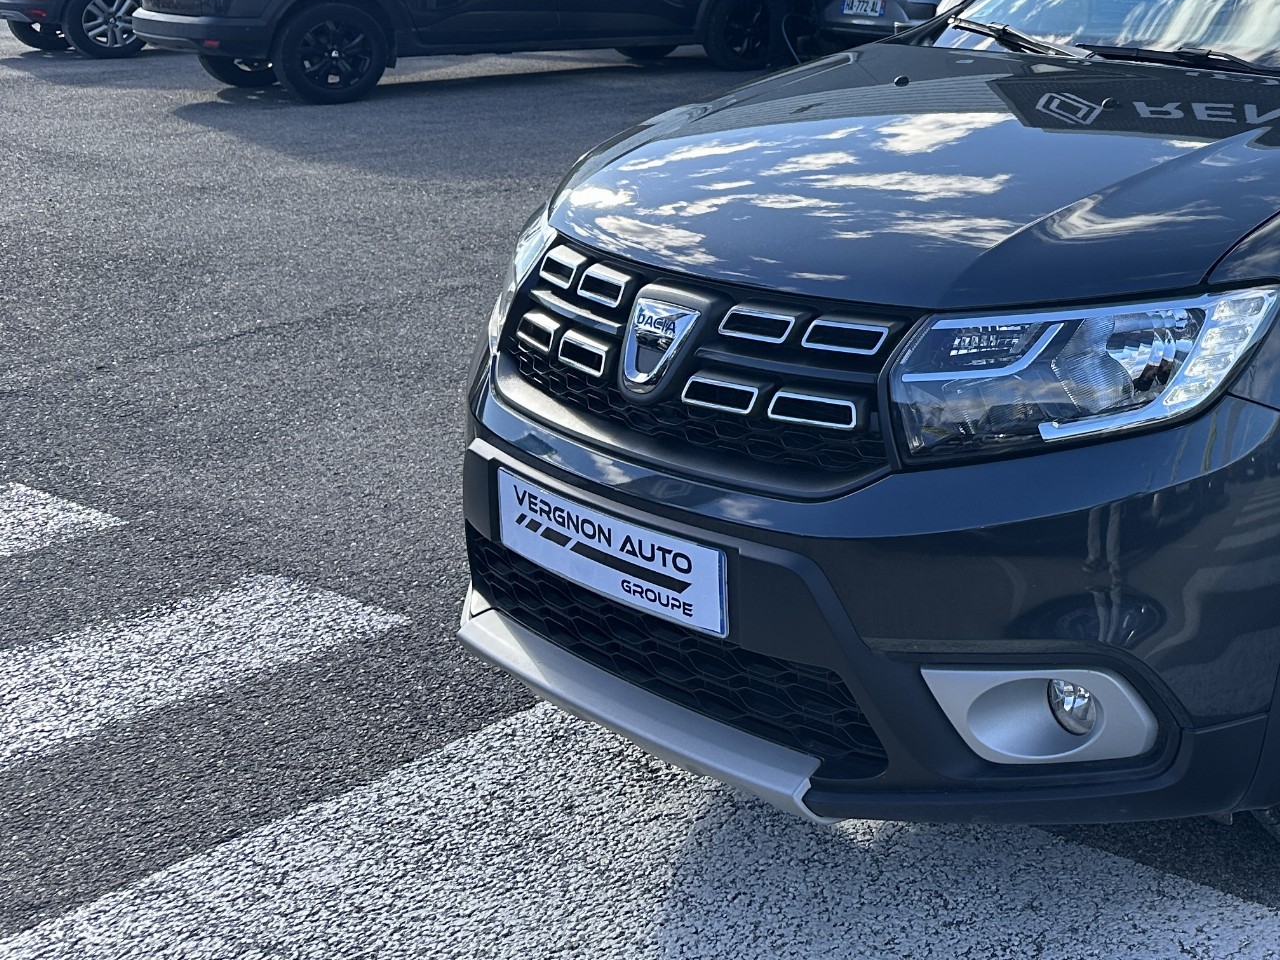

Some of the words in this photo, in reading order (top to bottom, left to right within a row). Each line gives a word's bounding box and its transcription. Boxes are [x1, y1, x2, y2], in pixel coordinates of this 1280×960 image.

[636, 311, 677, 334] DACIA
[513, 485, 612, 548] VERGNON
[619, 534, 693, 575] AUTO
[621, 578, 694, 618] GROUPE
